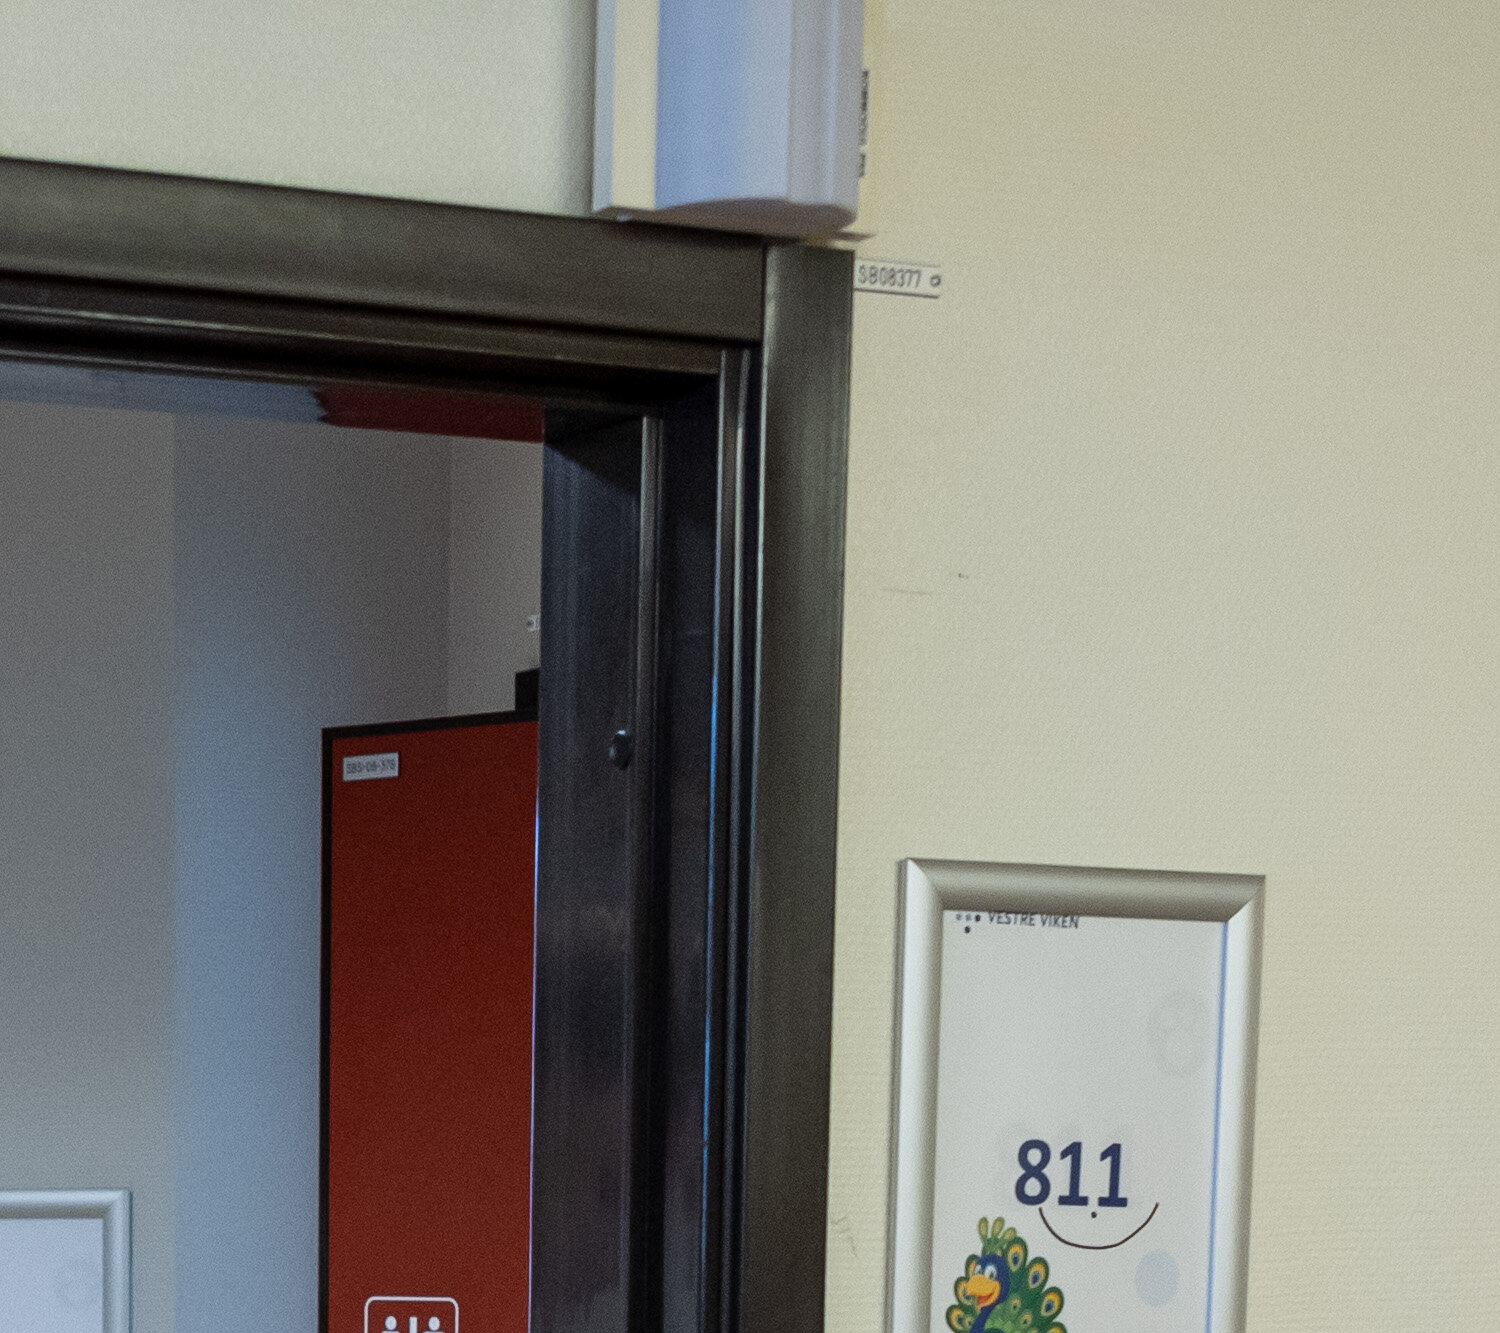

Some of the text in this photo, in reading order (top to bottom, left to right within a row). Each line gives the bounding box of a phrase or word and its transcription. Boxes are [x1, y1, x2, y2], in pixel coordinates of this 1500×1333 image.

[988, 911, 1080, 929] VESTRE VIKEN
[1014, 1138, 1129, 1208] 811
